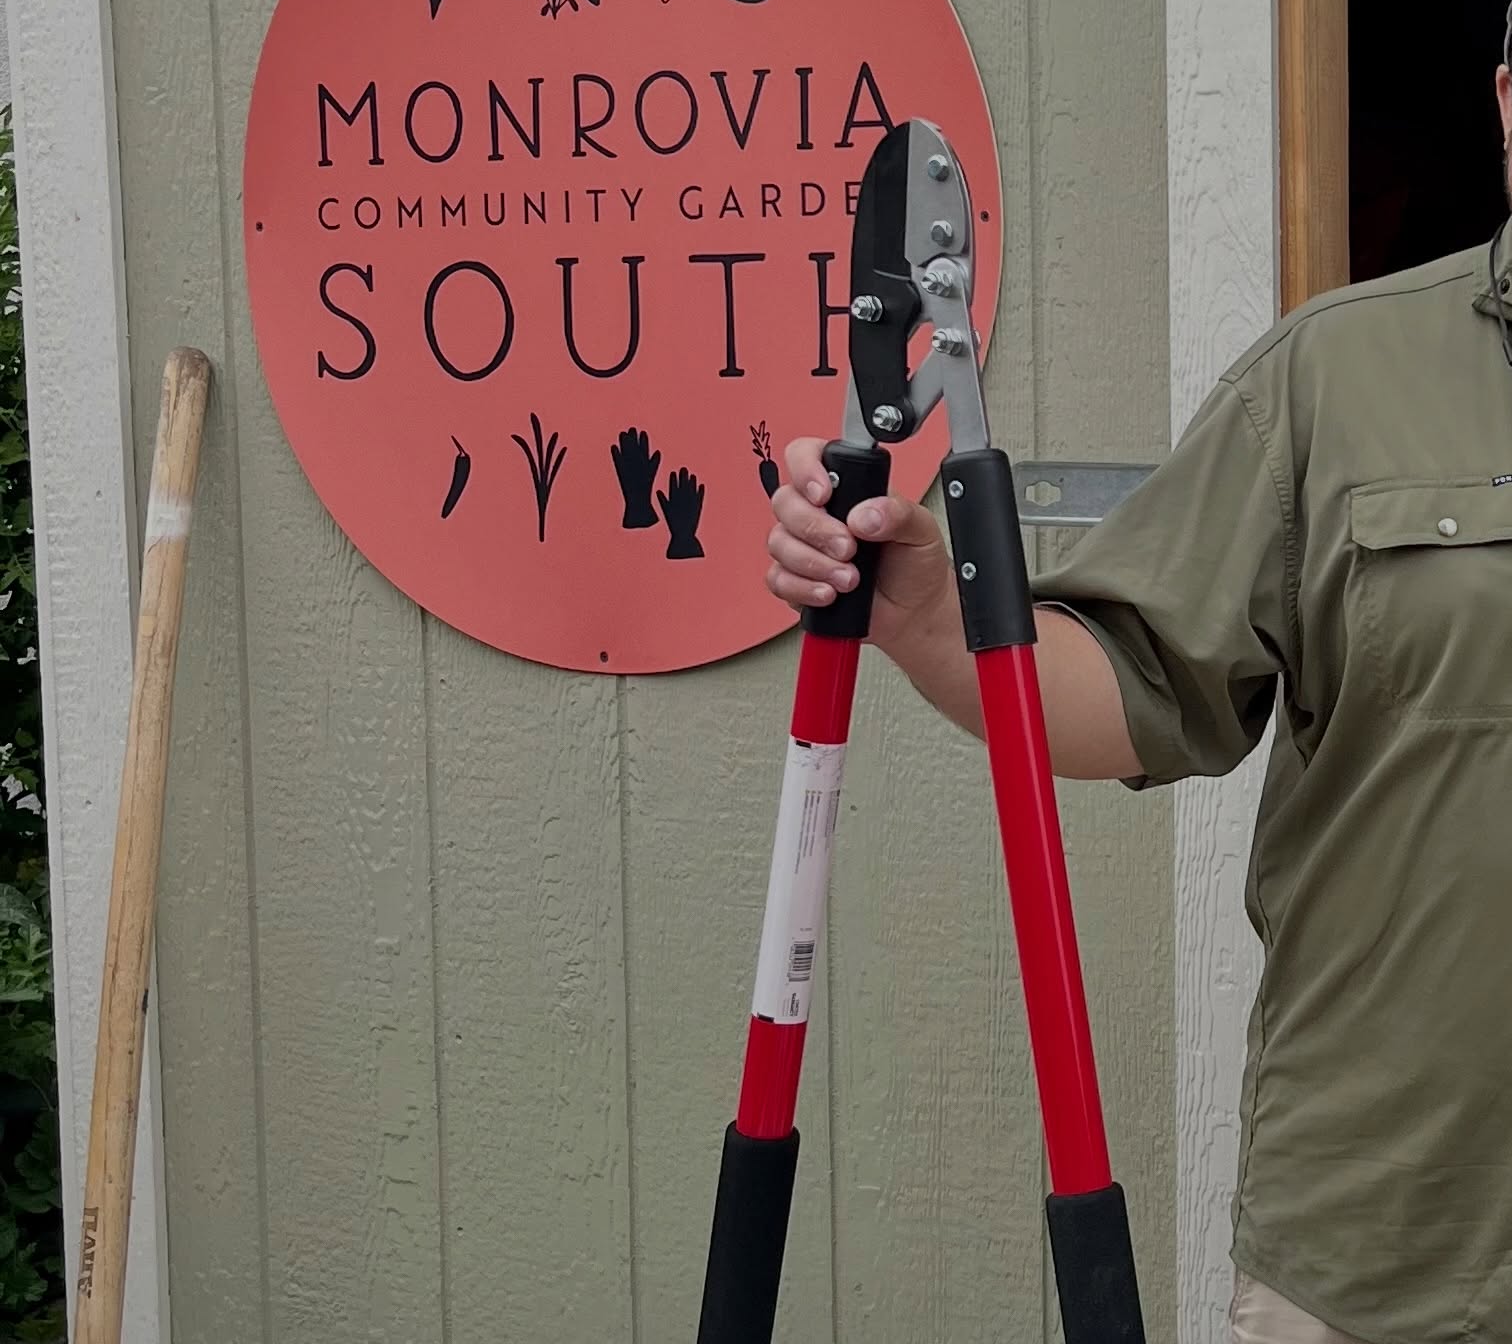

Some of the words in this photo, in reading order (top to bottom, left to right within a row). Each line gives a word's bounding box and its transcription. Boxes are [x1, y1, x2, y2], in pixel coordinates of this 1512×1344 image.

[317, 61, 894, 168] MONROVIA
[317, 187, 644, 231] COMMUNITY
[678, 181, 862, 220] GARDE
